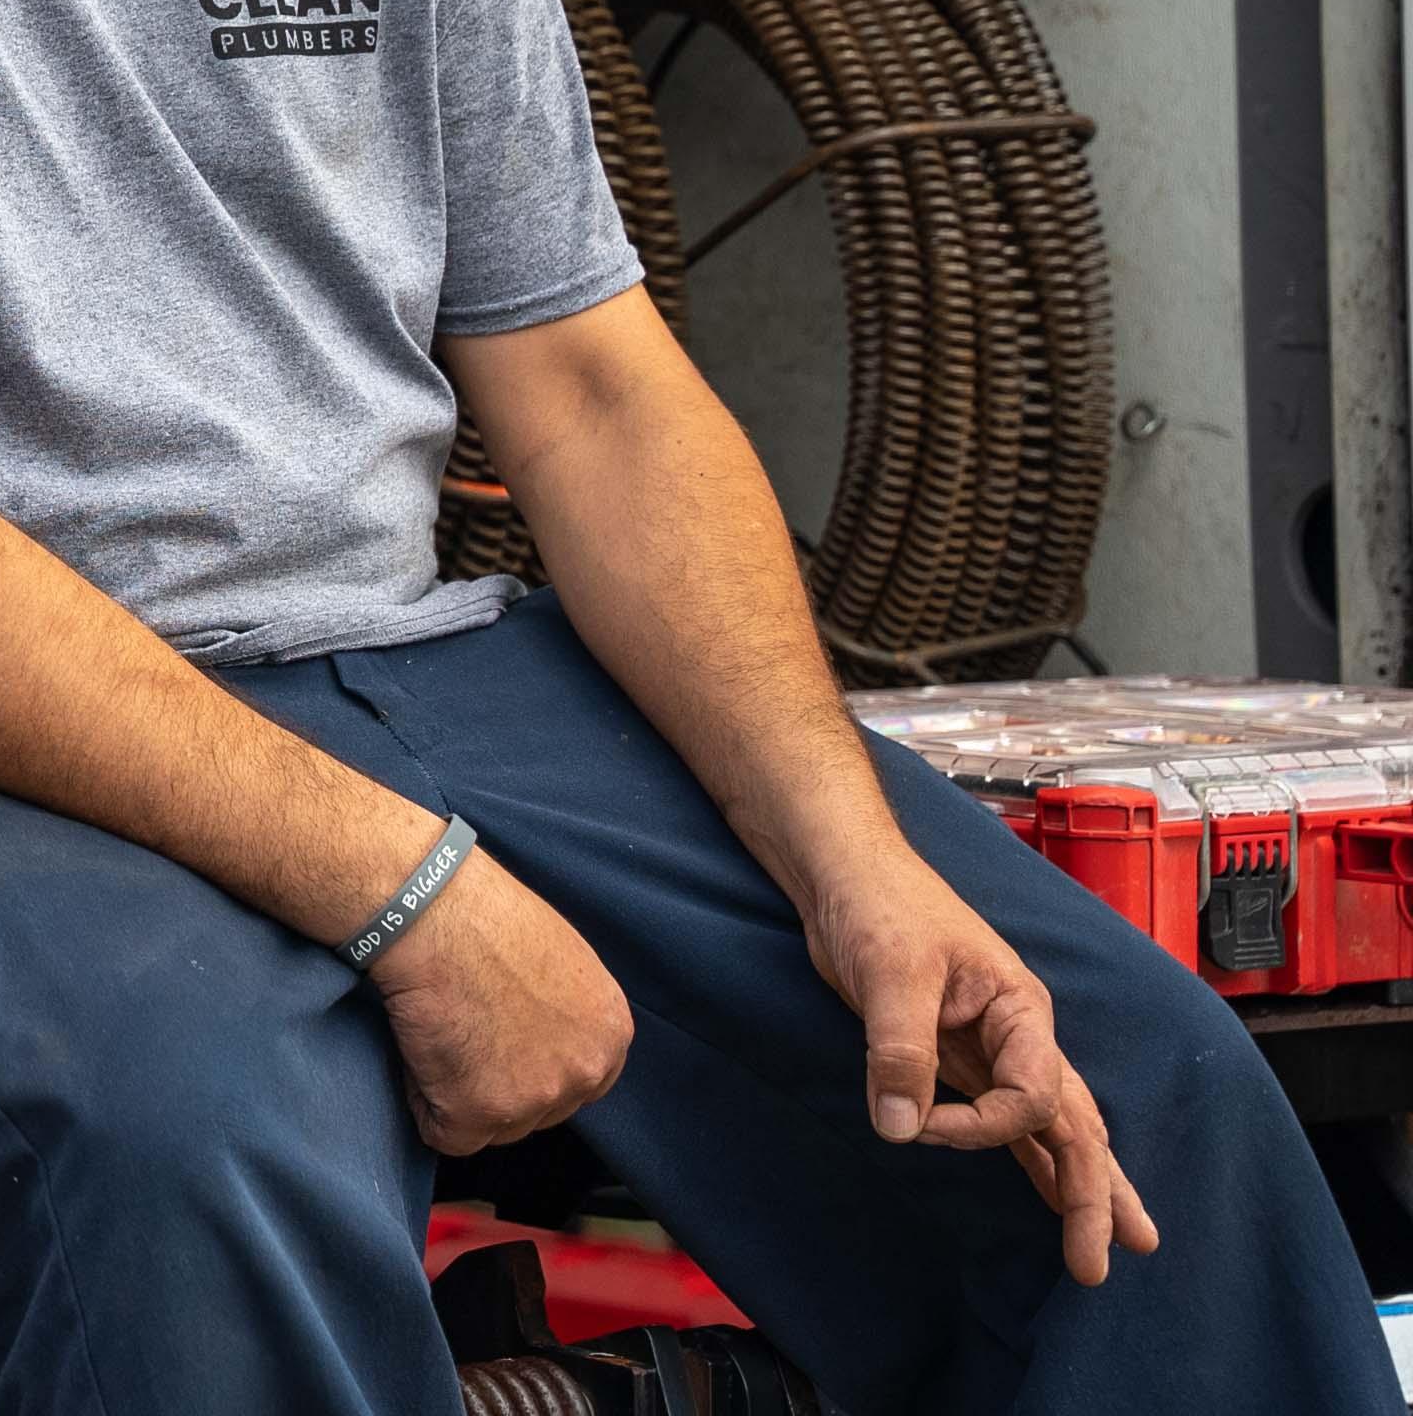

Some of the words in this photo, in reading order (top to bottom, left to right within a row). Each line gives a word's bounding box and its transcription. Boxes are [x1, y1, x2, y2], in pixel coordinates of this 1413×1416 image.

[220, 26, 377, 54] PLUMBERS
[350, 932, 381, 961] GOD
[381, 911, 404, 932] IS
[401, 845, 458, 910] BIGGER
